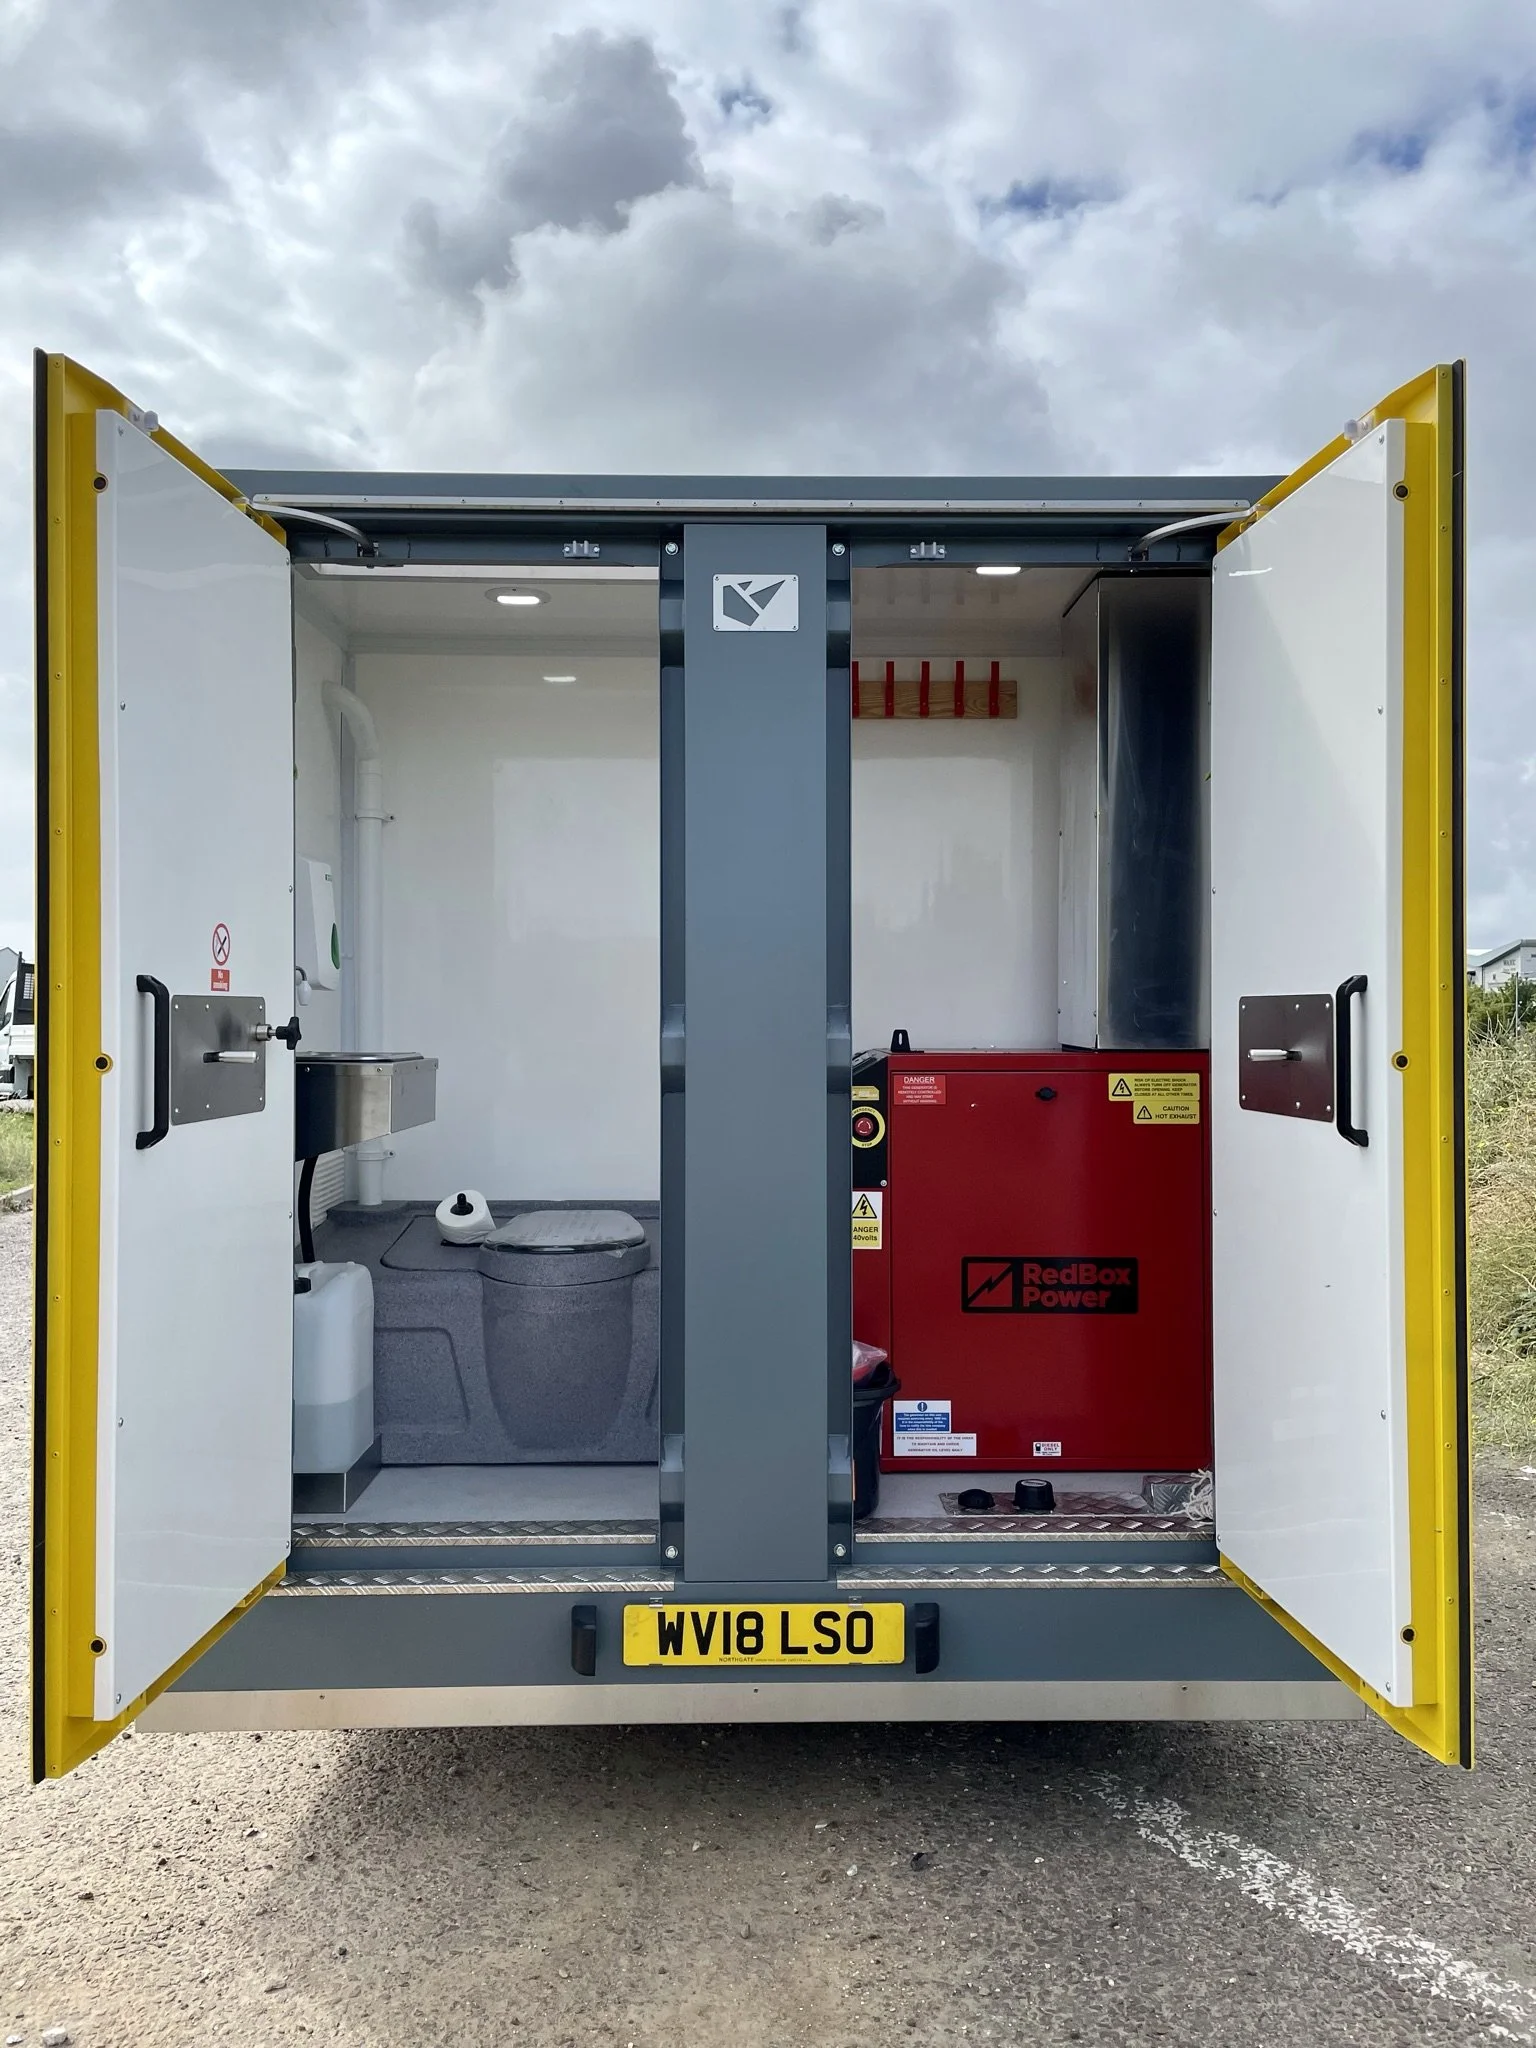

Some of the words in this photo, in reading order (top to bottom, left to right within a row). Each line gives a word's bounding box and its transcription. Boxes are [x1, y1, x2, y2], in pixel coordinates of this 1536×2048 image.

[903, 1076, 935, 1084] DANGER
[1023, 1263, 1131, 1285] RedBox
[1023, 1286, 1111, 1308] Power
[657, 1610, 764, 1656] WV18
[780, 1610, 874, 1656] LSO
